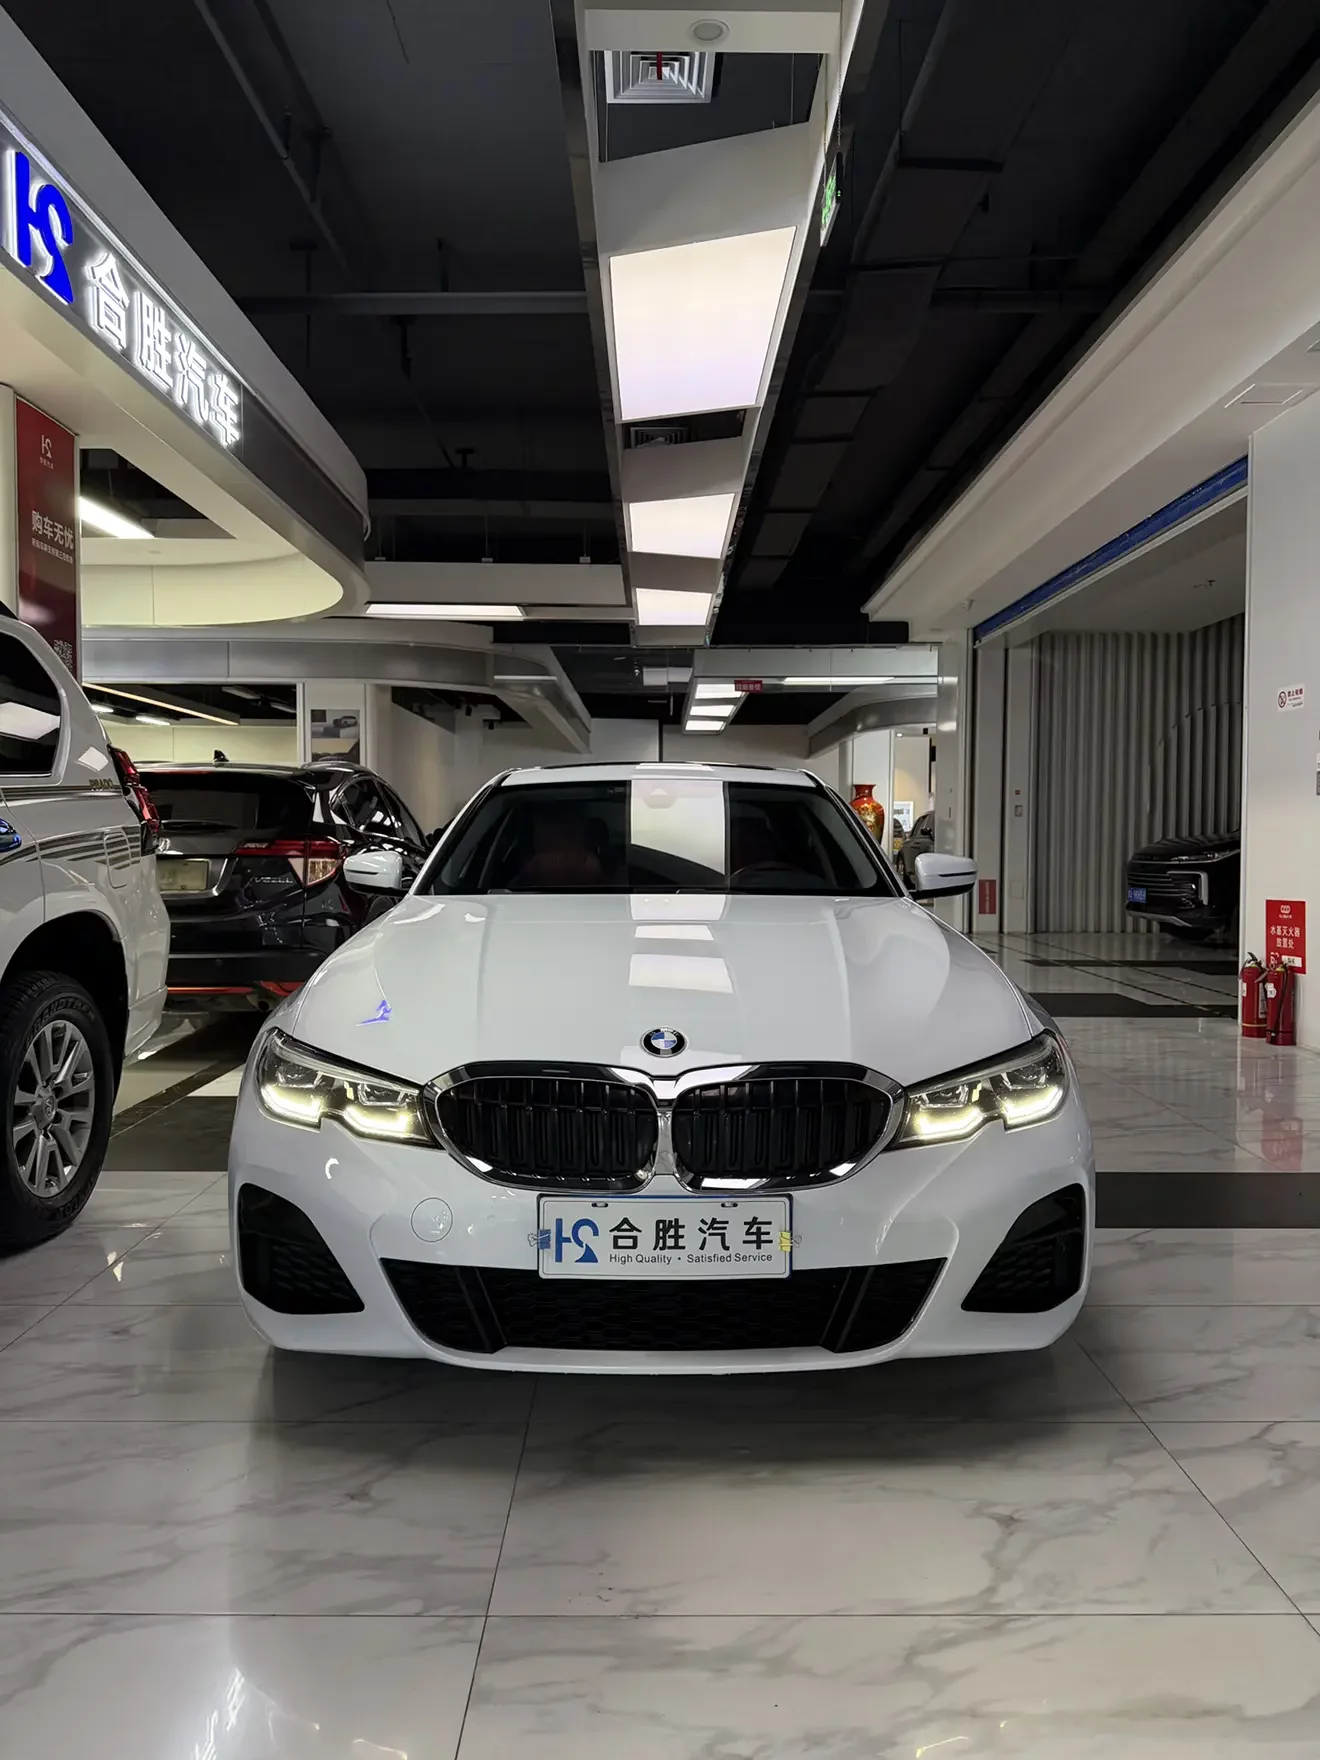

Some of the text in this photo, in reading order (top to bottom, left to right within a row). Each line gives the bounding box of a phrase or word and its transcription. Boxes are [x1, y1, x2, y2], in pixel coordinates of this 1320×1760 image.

[84, 253, 241, 447] 合胜汽车
[31, 510, 75, 550] 购车无忧
[1270, 925, 1301, 938] 水基灭火器
[609, 1217, 774, 1251] 合胜汽车
[609, 1252, 773, 1265] High Quality Satisfied Service
